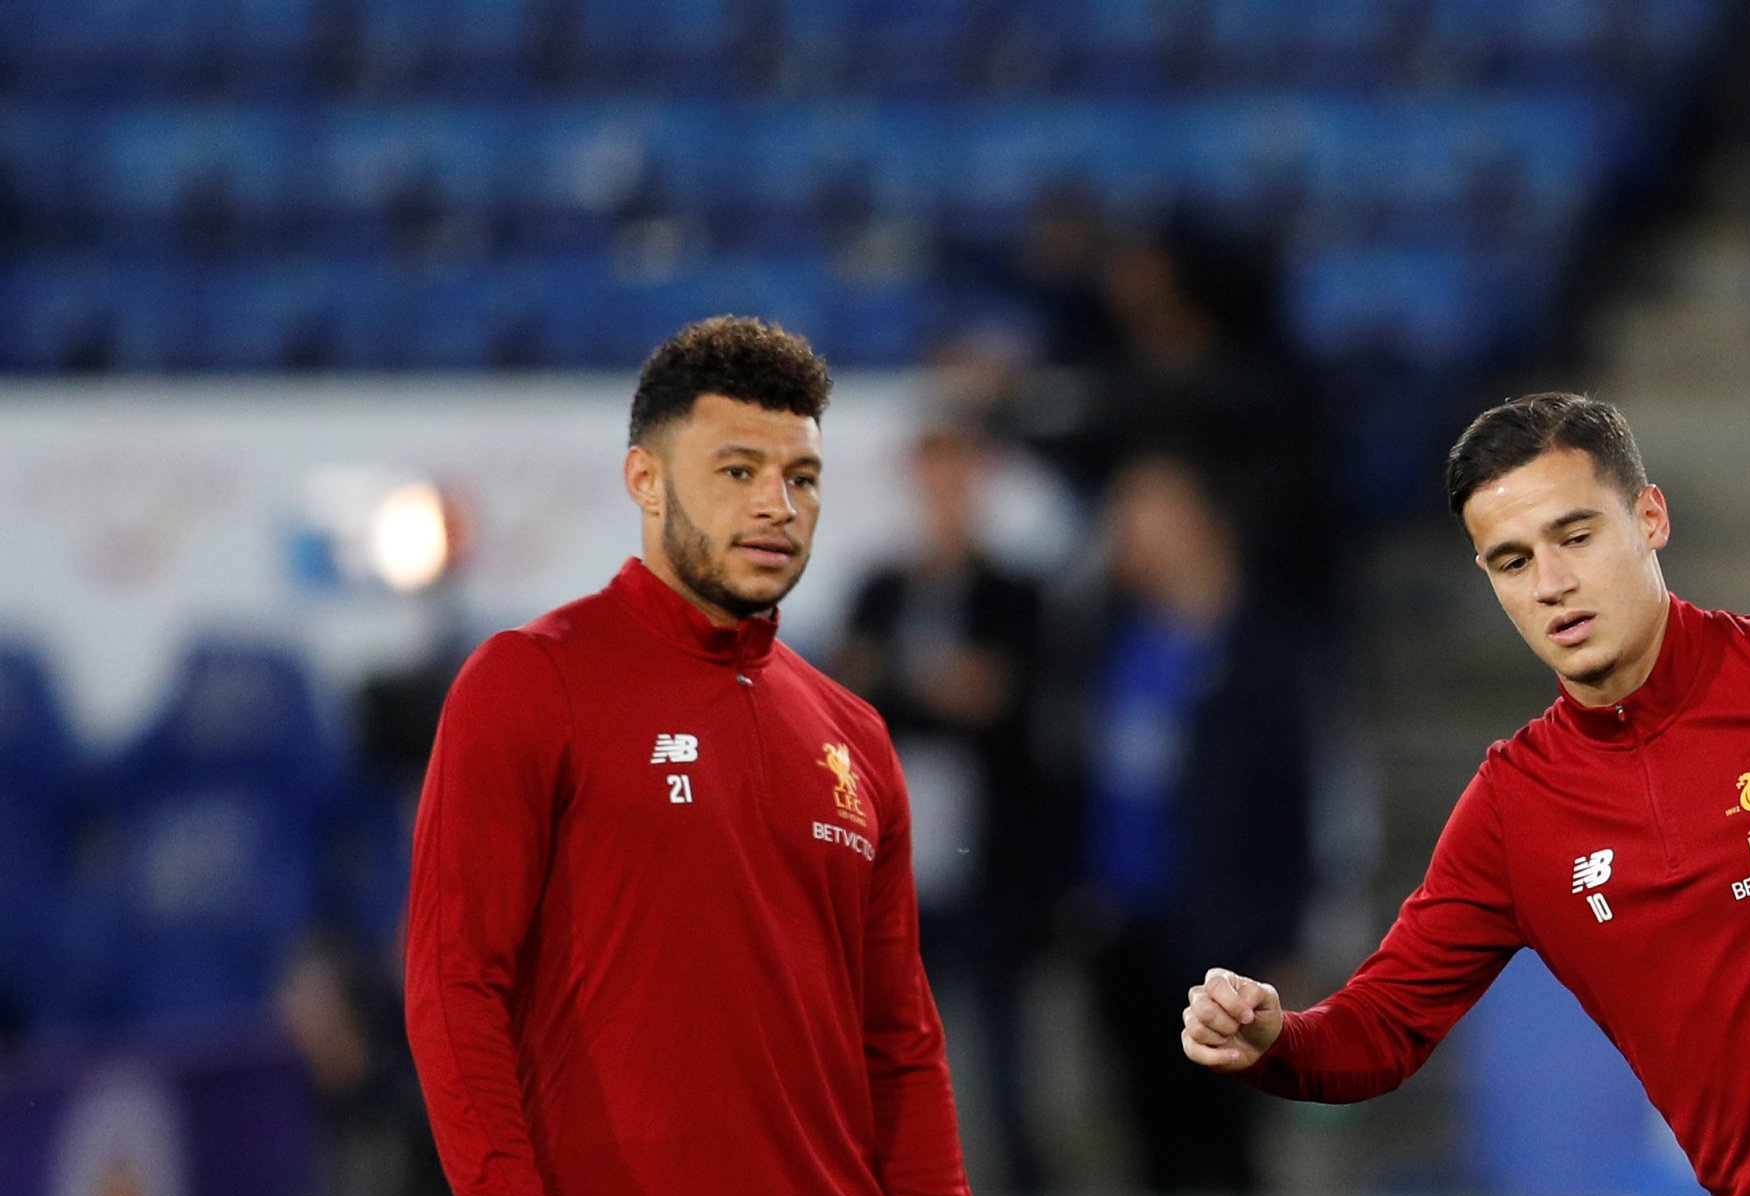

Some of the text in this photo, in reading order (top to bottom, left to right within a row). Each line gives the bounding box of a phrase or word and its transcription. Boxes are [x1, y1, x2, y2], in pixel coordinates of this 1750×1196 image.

[666, 774, 693, 803] 21
[812, 821, 876, 861] BETVICTO
[1586, 892, 1614, 923] 10
